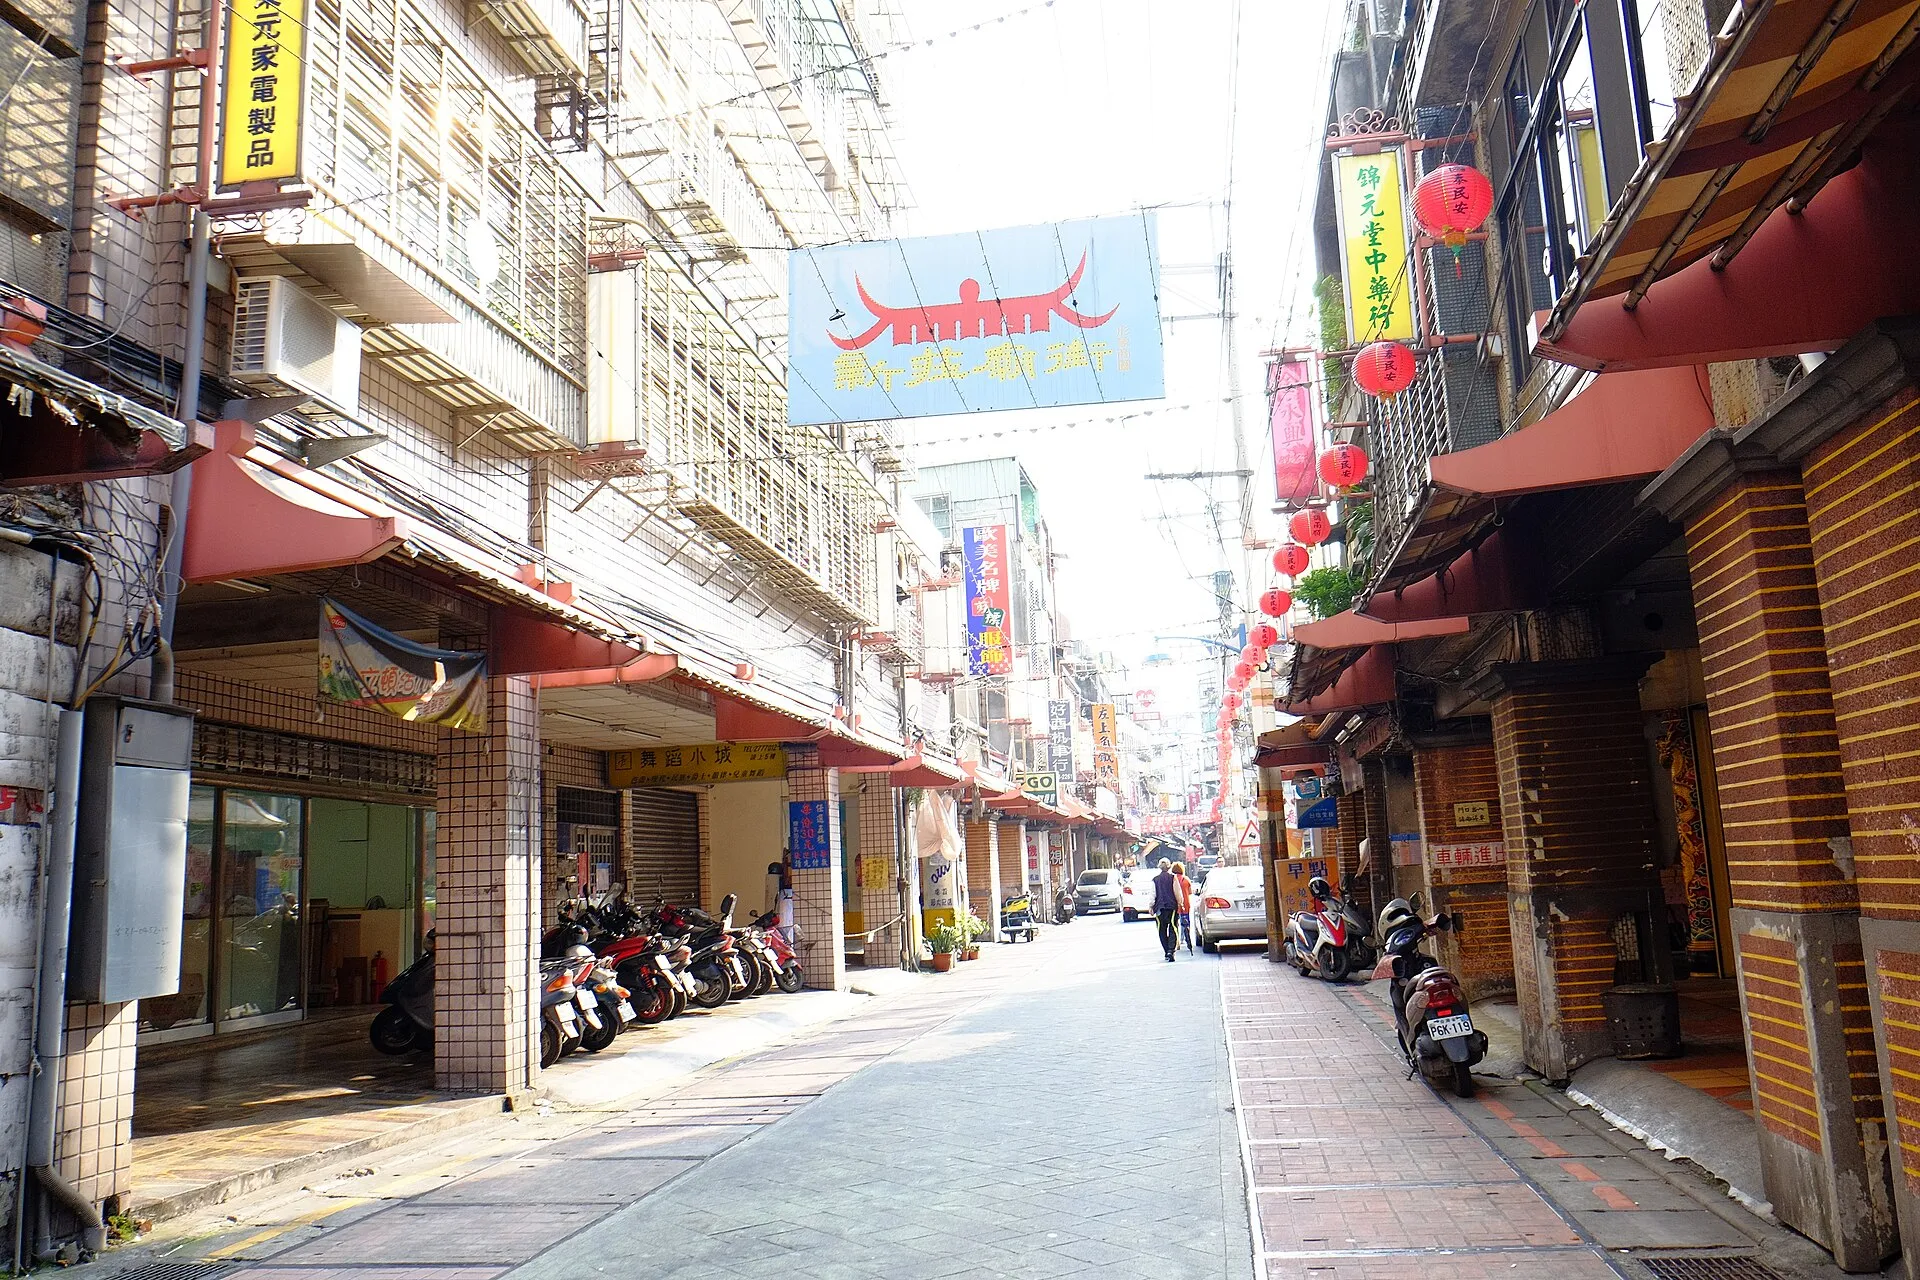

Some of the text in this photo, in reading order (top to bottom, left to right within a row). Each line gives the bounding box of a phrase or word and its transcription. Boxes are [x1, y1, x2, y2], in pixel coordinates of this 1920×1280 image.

[1357, 165, 1394, 330] 錦元堂中藥行
[640, 745, 733, 769] 舞蹈小城
[1049, 833, 1063, 865] 電視
[1287, 860, 1328, 880] 早點
